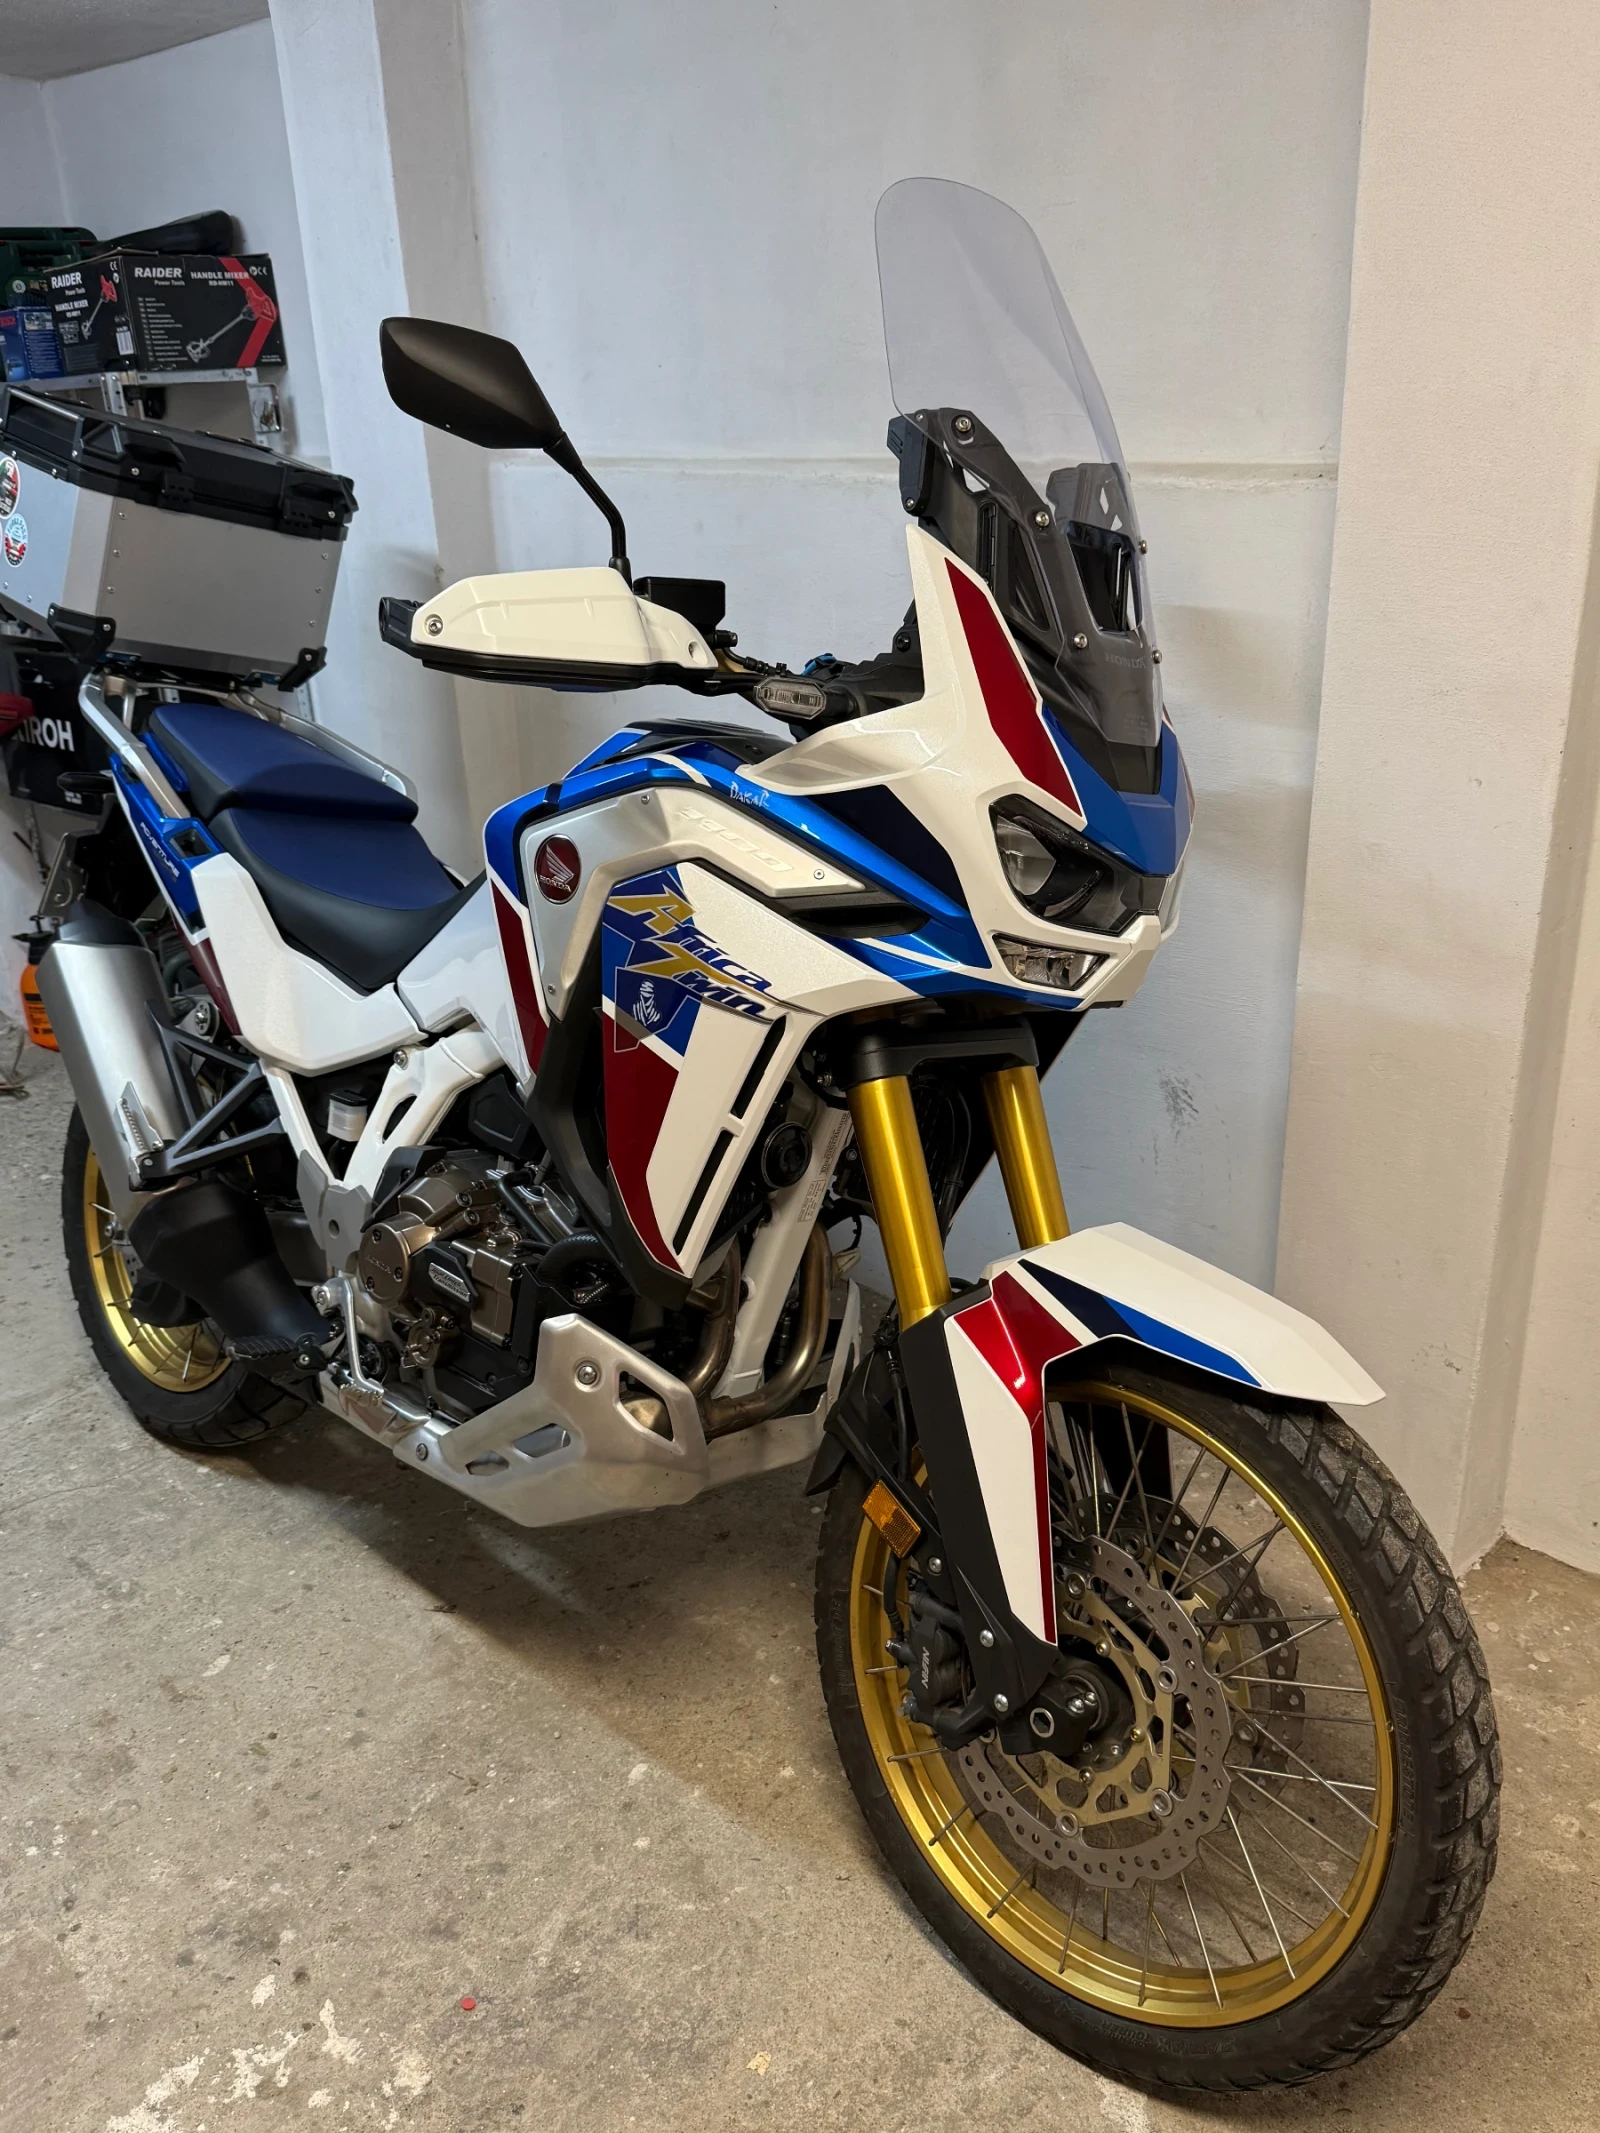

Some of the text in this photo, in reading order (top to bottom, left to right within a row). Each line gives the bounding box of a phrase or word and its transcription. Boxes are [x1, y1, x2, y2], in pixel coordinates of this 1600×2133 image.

[51, 272, 82, 289] RAIDER
[134, 267, 182, 278] RAIDER
[191, 271, 249, 279] HANDLE MIXER
[55, 299, 89, 312] HANDLE MIXER
[1104, 651, 1147, 669] HONDA
[730, 780, 770, 807] DAKAR
[140, 822, 180, 877] ADVENTURE
[540, 874, 572, 893] HONDA
[606, 883, 773, 994] Africa
[626, 936, 783, 1019] Twin
[1392, 1697, 1415, 1823] BRIDGESTONE
[1101, 2019, 1153, 2045] TOURER
